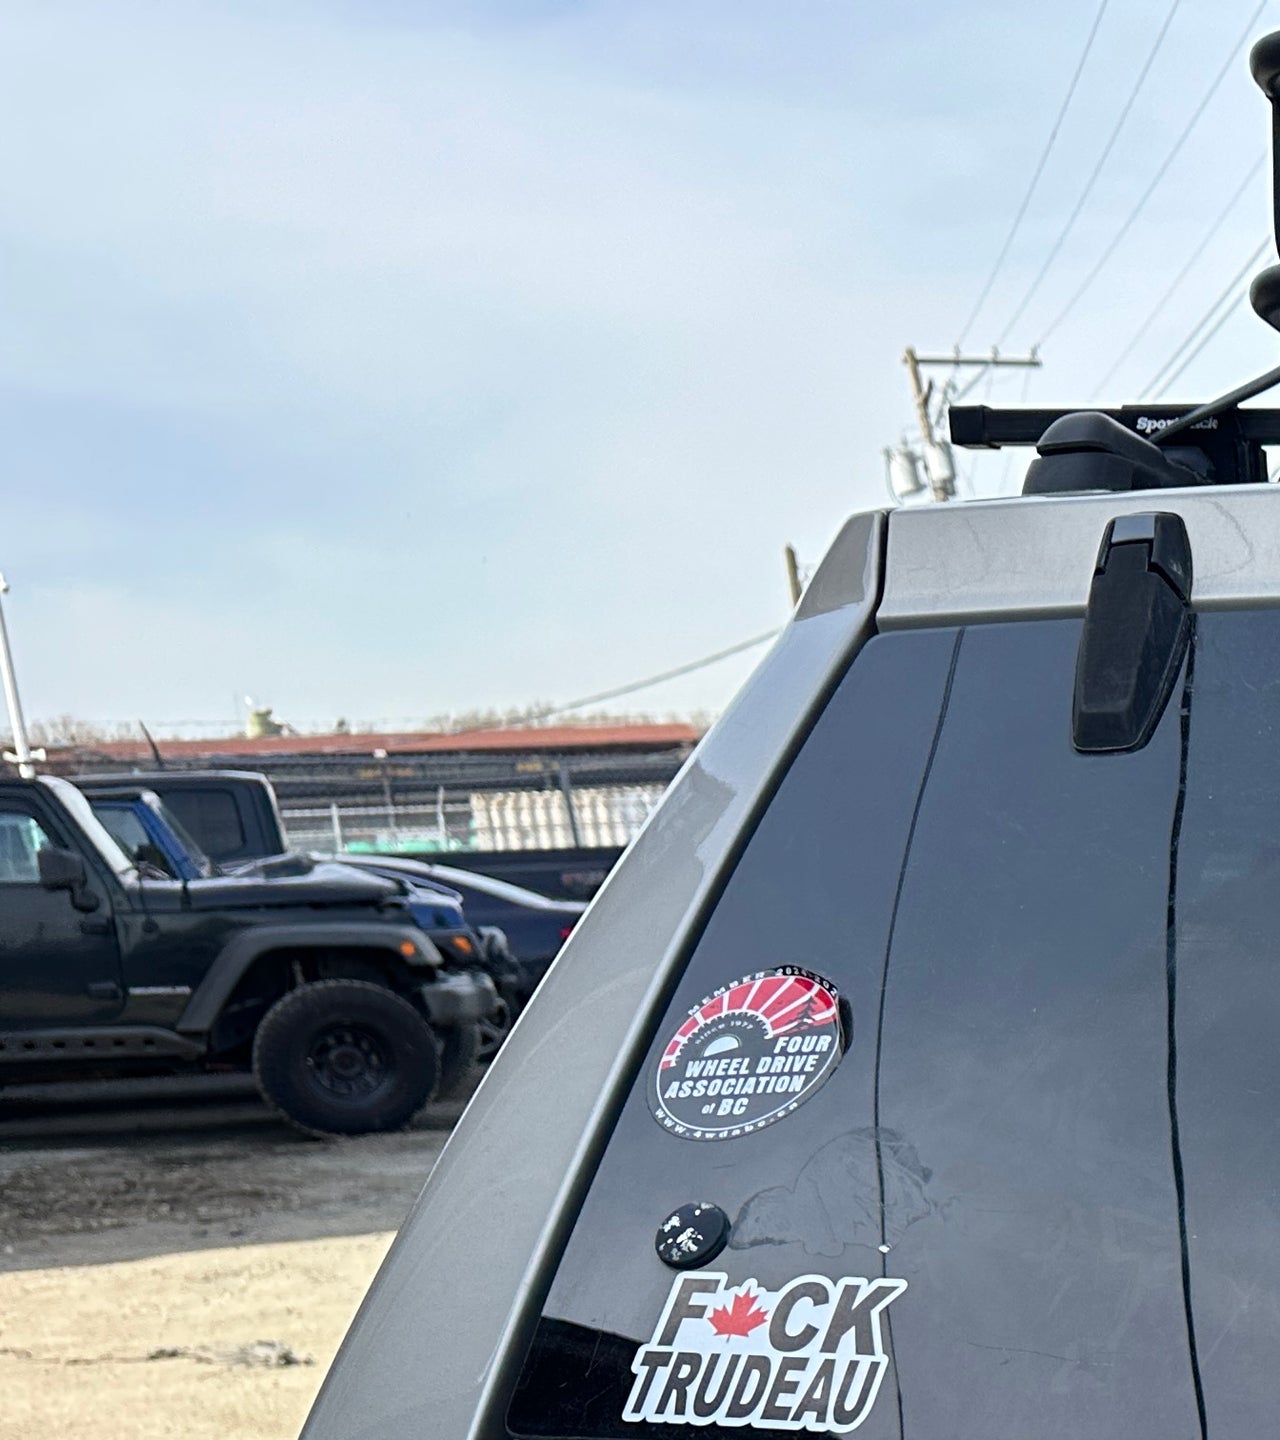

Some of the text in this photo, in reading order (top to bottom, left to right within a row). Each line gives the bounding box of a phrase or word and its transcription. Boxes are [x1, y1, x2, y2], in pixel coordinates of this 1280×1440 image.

[688, 972, 765, 1016] MEMBER
[773, 1035, 832, 1054] FOUR
[685, 1054, 819, 1078] WHEEL DRIVE
[664, 1074, 806, 1099] ASSOCIATION
[701, 1097, 749, 1116] of BC
[631, 1350, 881, 1427] TRUDEAU
